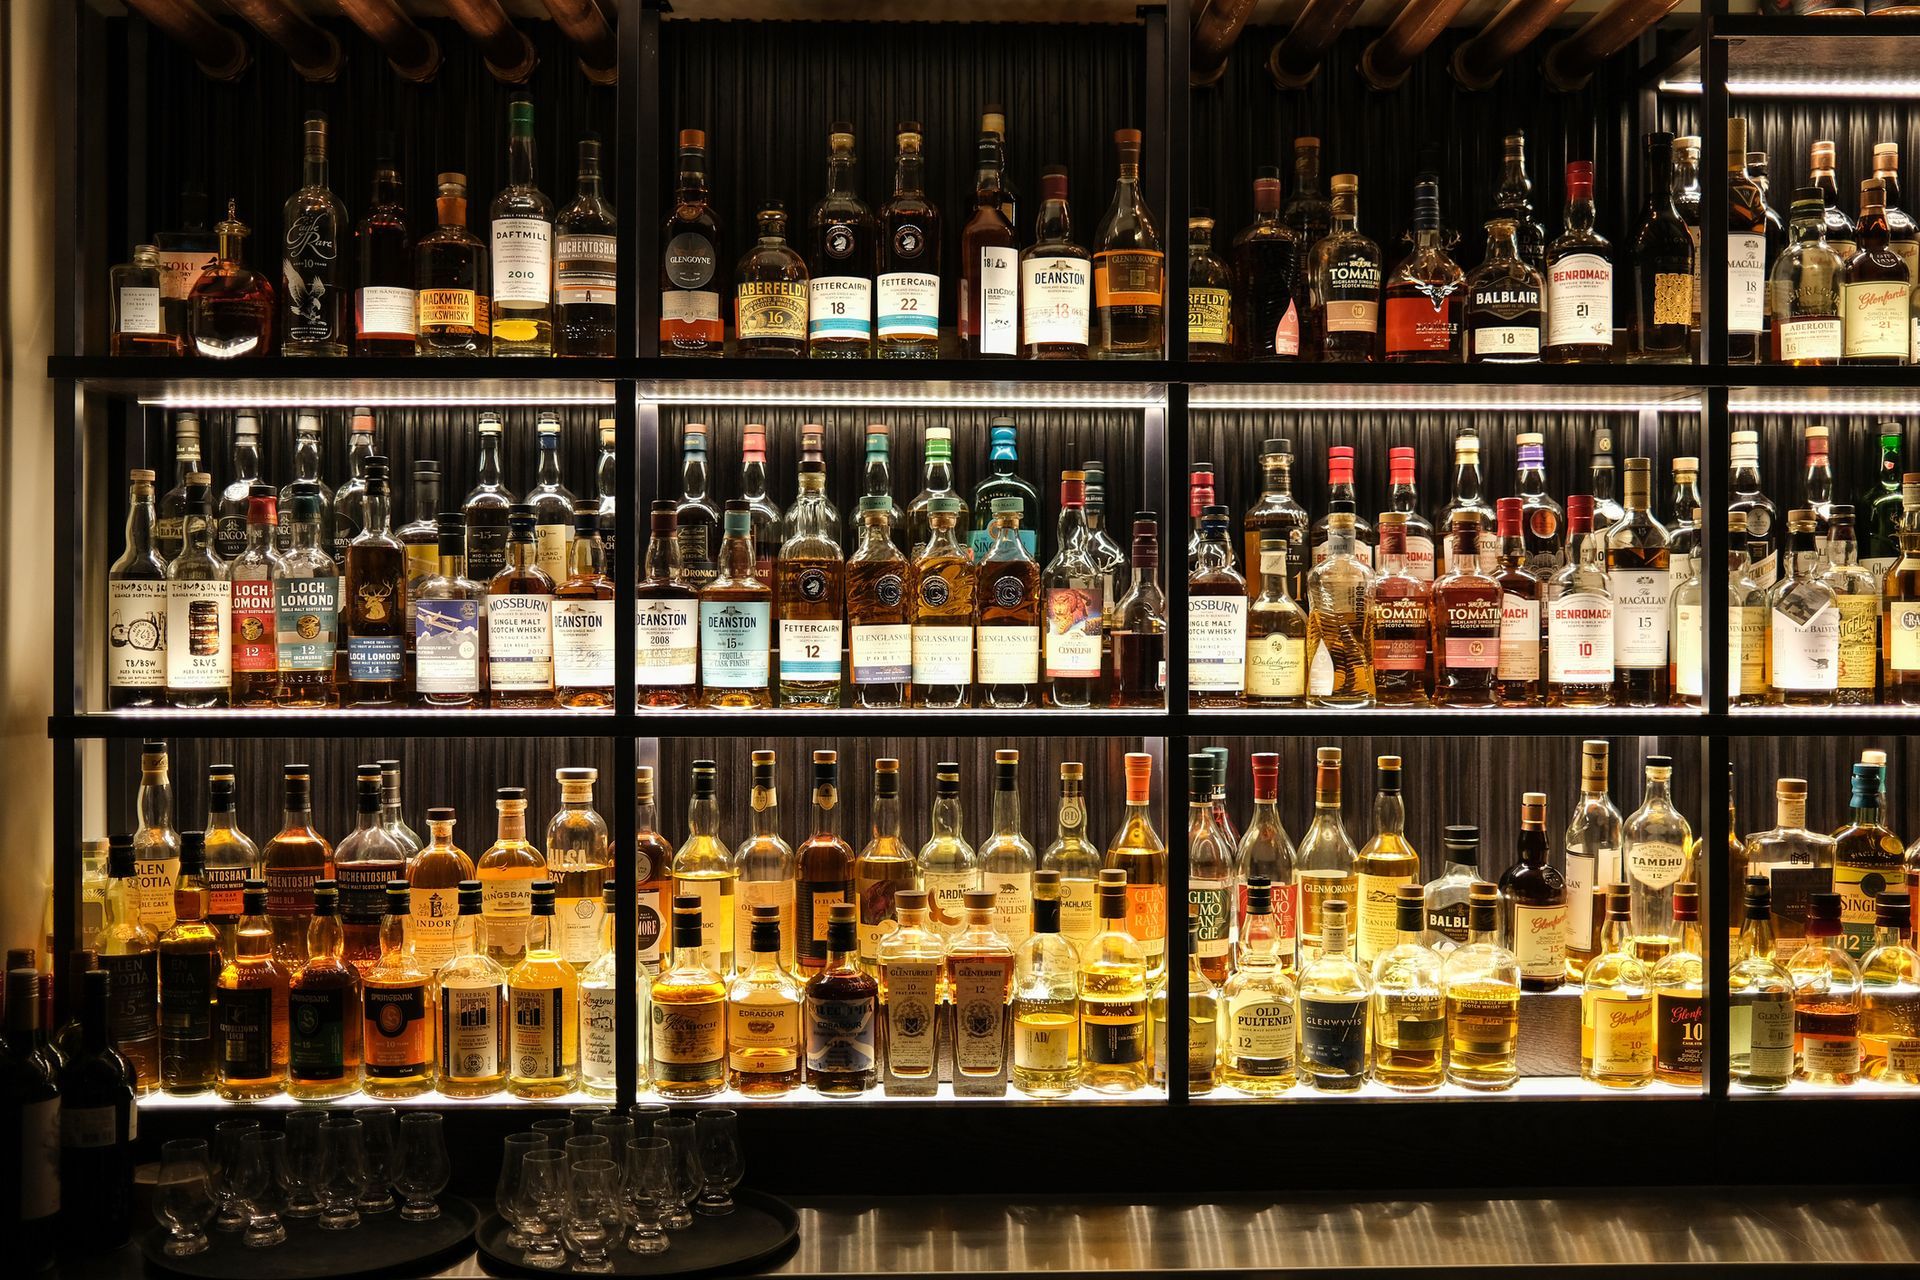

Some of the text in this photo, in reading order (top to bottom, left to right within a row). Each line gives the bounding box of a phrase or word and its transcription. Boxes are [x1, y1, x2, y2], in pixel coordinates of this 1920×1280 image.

[496, 231, 547, 241] DAFTMILL
[304, 259, 313, 268] 10
[670, 256, 711, 265] GLENGOYNE
[984, 259, 991, 267] 18
[1035, 272, 1084, 285] DEANSTON
[1330, 268, 1381, 280] TOMATIN
[1554, 270, 1609, 281] BENROMACH
[812, 282, 867, 292] FETTERCAIRN
[882, 278, 936, 287] FETTERCAIRN
[1746, 281, 1756, 291] 18
[741, 284, 807, 297] ABERFELDY
[423, 293, 469, 305] MACKMYRA
[1476, 292, 1538, 304] BALBLAIR
[831, 302, 845, 314] 18
[900, 298, 917, 311] 22
[1134, 305, 1143, 314] 18
[1577, 304, 1589, 316] 21
[423, 311, 470, 322] BRUKSWHISKY
[767, 311, 783, 324] 16
[1189, 313, 1202, 324] 21
[1789, 322, 1834, 330] ABERLOUR
[1879, 320, 1891, 329] 21
[1502, 333, 1514, 344] 18
[1786, 343, 1796, 352] 16
[236, 585, 268, 597] LOCH
[290, 582, 325, 593] LOCH
[281, 594, 333, 606] LOMOND
[490, 598, 548, 612] MOSSBURN
[1619, 597, 1667, 605] MACALLAN
[1375, 608, 1428, 620] TOMATIN
[1449, 608, 1501, 620] TOMATIN
[1556, 609, 1611, 619] BENROMACH
[555, 615, 602, 628] DEANSTON
[637, 614, 687, 626] DEANSTON
[709, 617, 756, 628] DEANSTON
[1638, 617, 1651, 628] 15
[784, 624, 839, 632] FETTERCAIRN
[650, 636, 670, 644] 2008
[727, 637, 737, 649] 15
[245, 647, 259, 656] 12
[301, 645, 315, 654] 12
[805, 645, 819, 658] 12
[1058, 646, 1091, 655] CLYNELISH
[1471, 644, 1481, 652] 14
[1578, 644, 1592, 656] 10
[349, 652, 400, 661] LOCH LOMOND
[126, 659, 156, 668] TB/BSW
[193, 658, 217, 667] SRVS
[1632, 857, 1682, 866] TAMDHU
[338, 870, 398, 882] AUCHENTOSHAN
[549, 873, 565, 884] BAY
[1135, 890, 1164, 901] GLEN
[1189, 891, 1220, 904] GLEN
[1148, 903, 1163, 913] MO
[1199, 904, 1222, 915] MO
[1003, 916, 1011, 924] 14
[1135, 916, 1159, 926] RAN
[1146, 927, 1161, 938] GIE
[1199, 927, 1218, 940] GIE
[1841, 935, 1860, 950] 12
[739, 1010, 784, 1018] EDRADOUR
[1256, 1007, 1280, 1017] OLD
[1758, 1012, 1778, 1021] GLEN
[817, 1021, 861, 1029] EDRADOUR
[1238, 1014, 1293, 1025] PULTENEY
[1306, 1017, 1362, 1026] GLENWYVIS
[1682, 1023, 1702, 1040] 10
[1238, 1037, 1252, 1048] 12
[1631, 1041, 1641, 1049] 10
